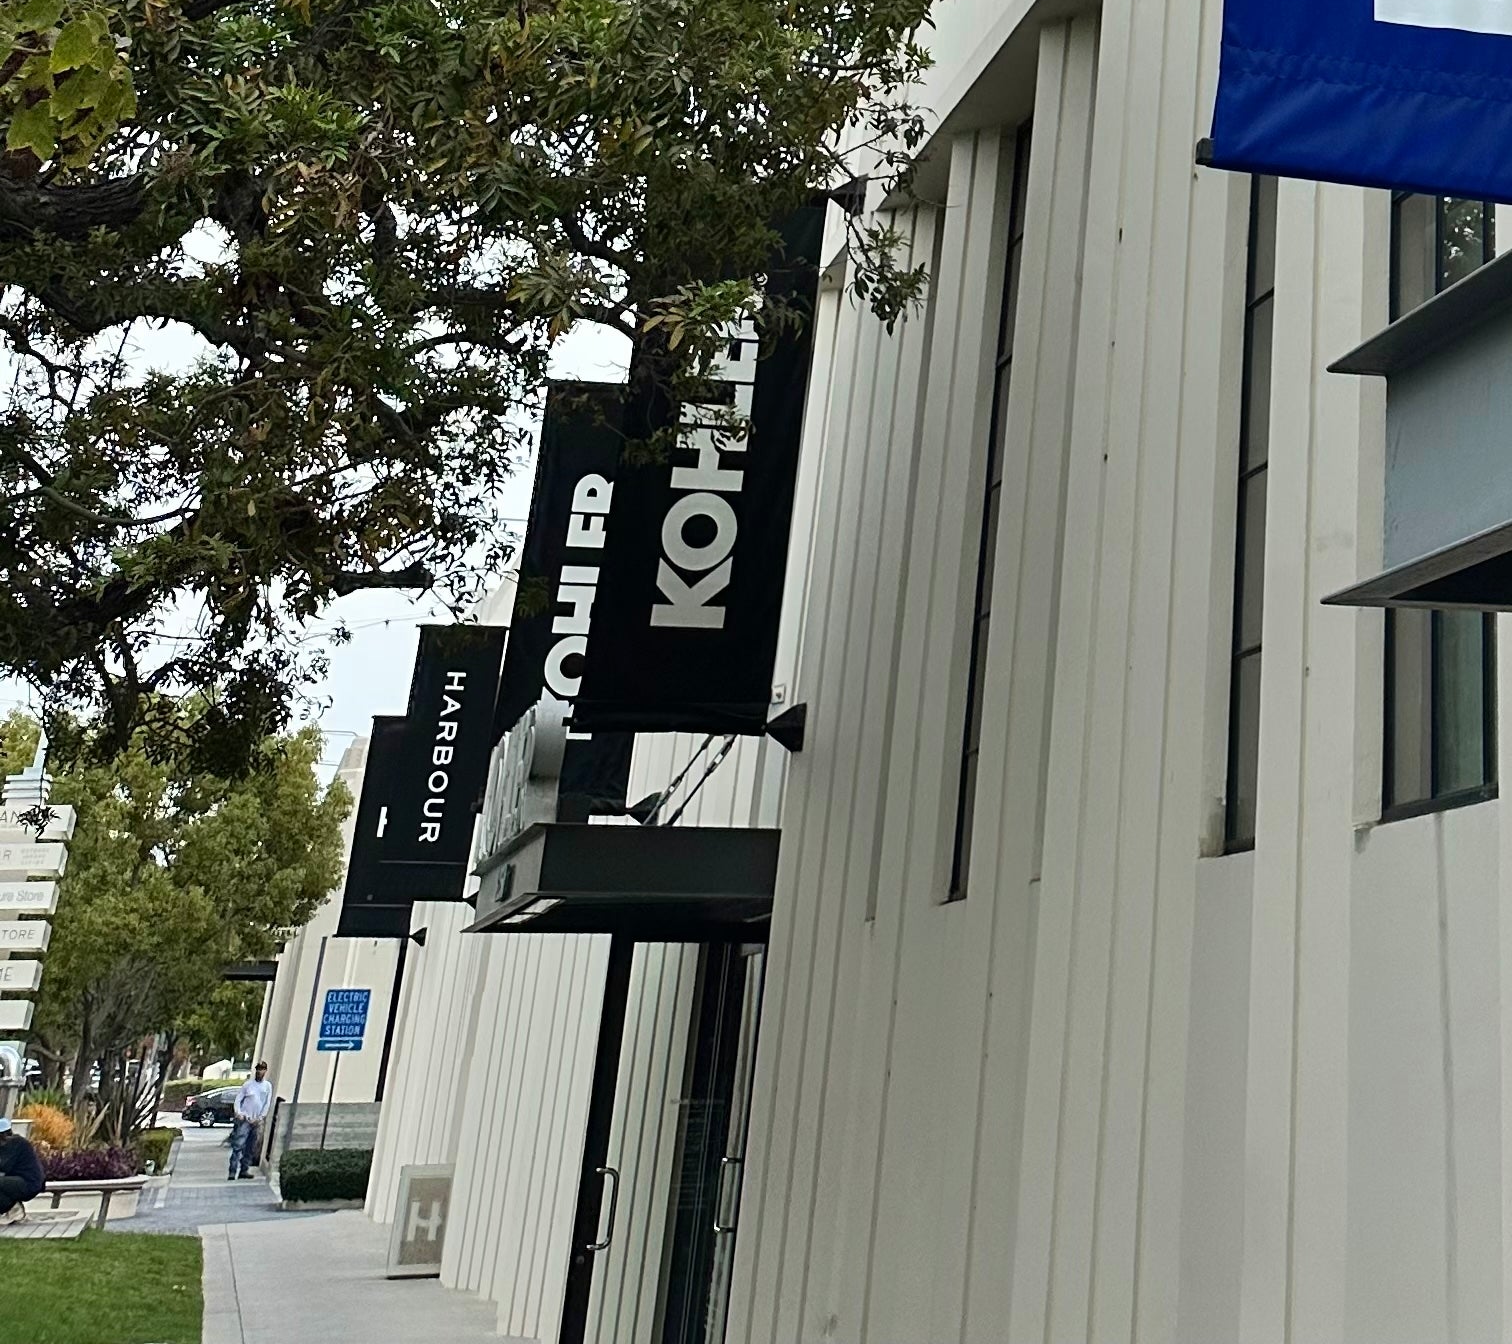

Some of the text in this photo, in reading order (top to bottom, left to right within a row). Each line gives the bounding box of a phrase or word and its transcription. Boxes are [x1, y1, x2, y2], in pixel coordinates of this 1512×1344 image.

[418, 671, 467, 843] HARBOUR
[1, 929, 36, 940] TORE
[327, 991, 369, 1003] ELECTRIC
[329, 1003, 365, 1013] VEHICLE
[323, 1013, 366, 1024] CHARGING
[324, 1025, 361, 1035] STATION
